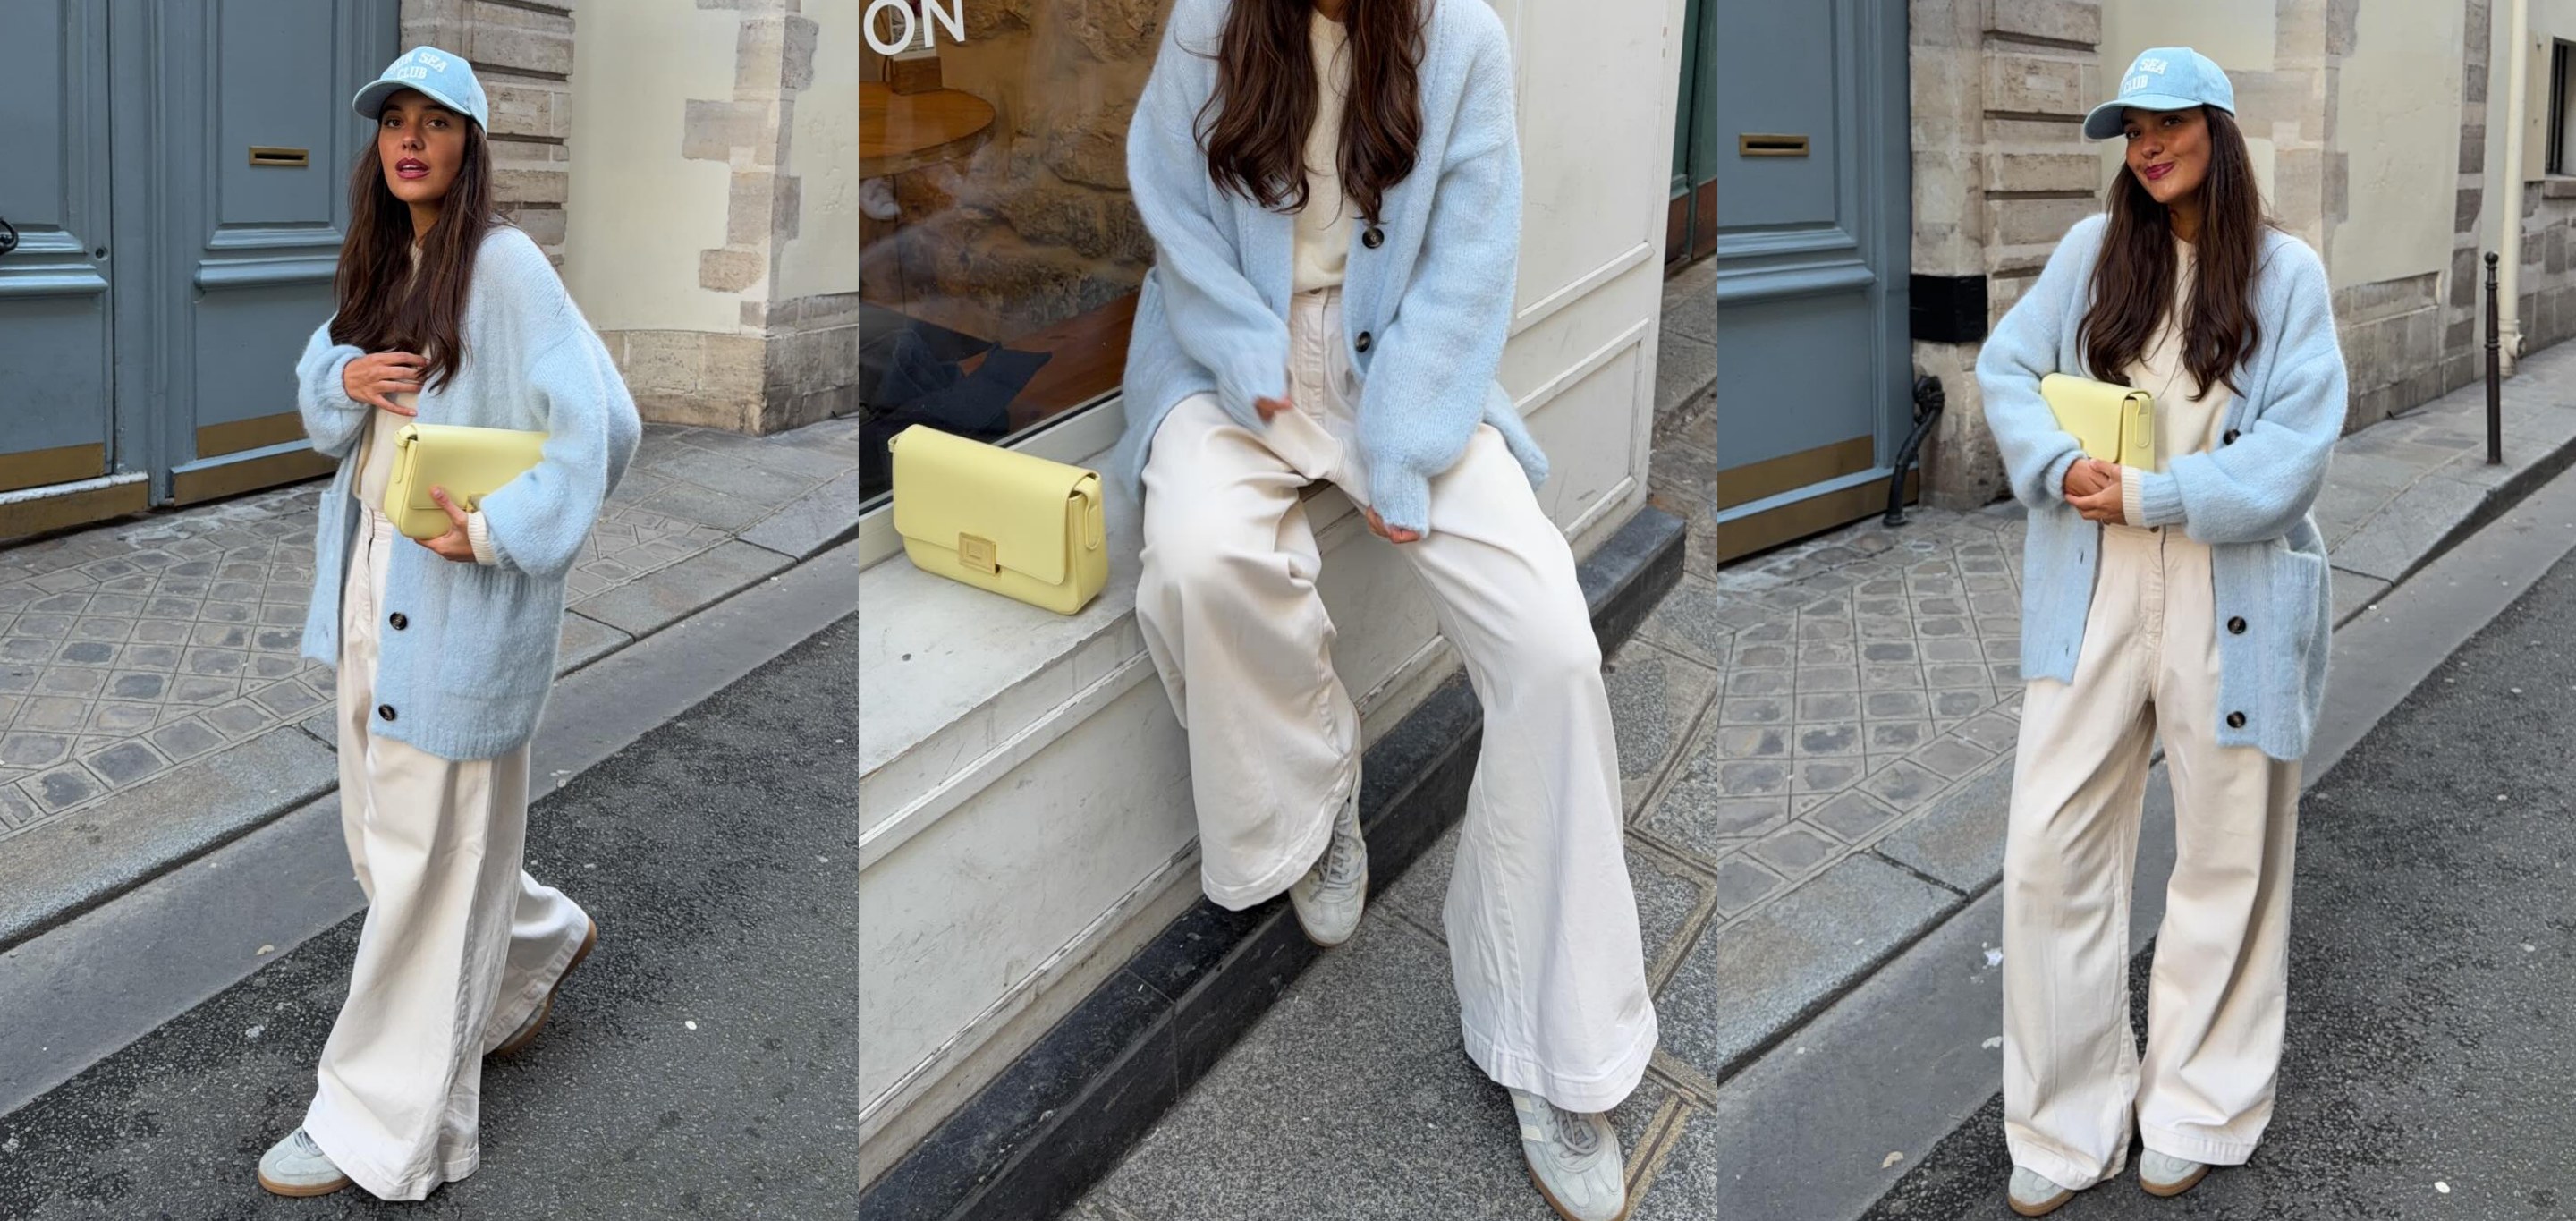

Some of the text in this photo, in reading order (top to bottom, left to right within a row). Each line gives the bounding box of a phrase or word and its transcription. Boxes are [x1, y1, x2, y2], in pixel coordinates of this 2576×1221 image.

[863, 0, 965, 55] ON
[397, 66, 428, 79] CLUB
[419, 52, 448, 73] SEA
[2139, 58, 2168, 75] SEA
[2123, 74, 2148, 94] CLUB
